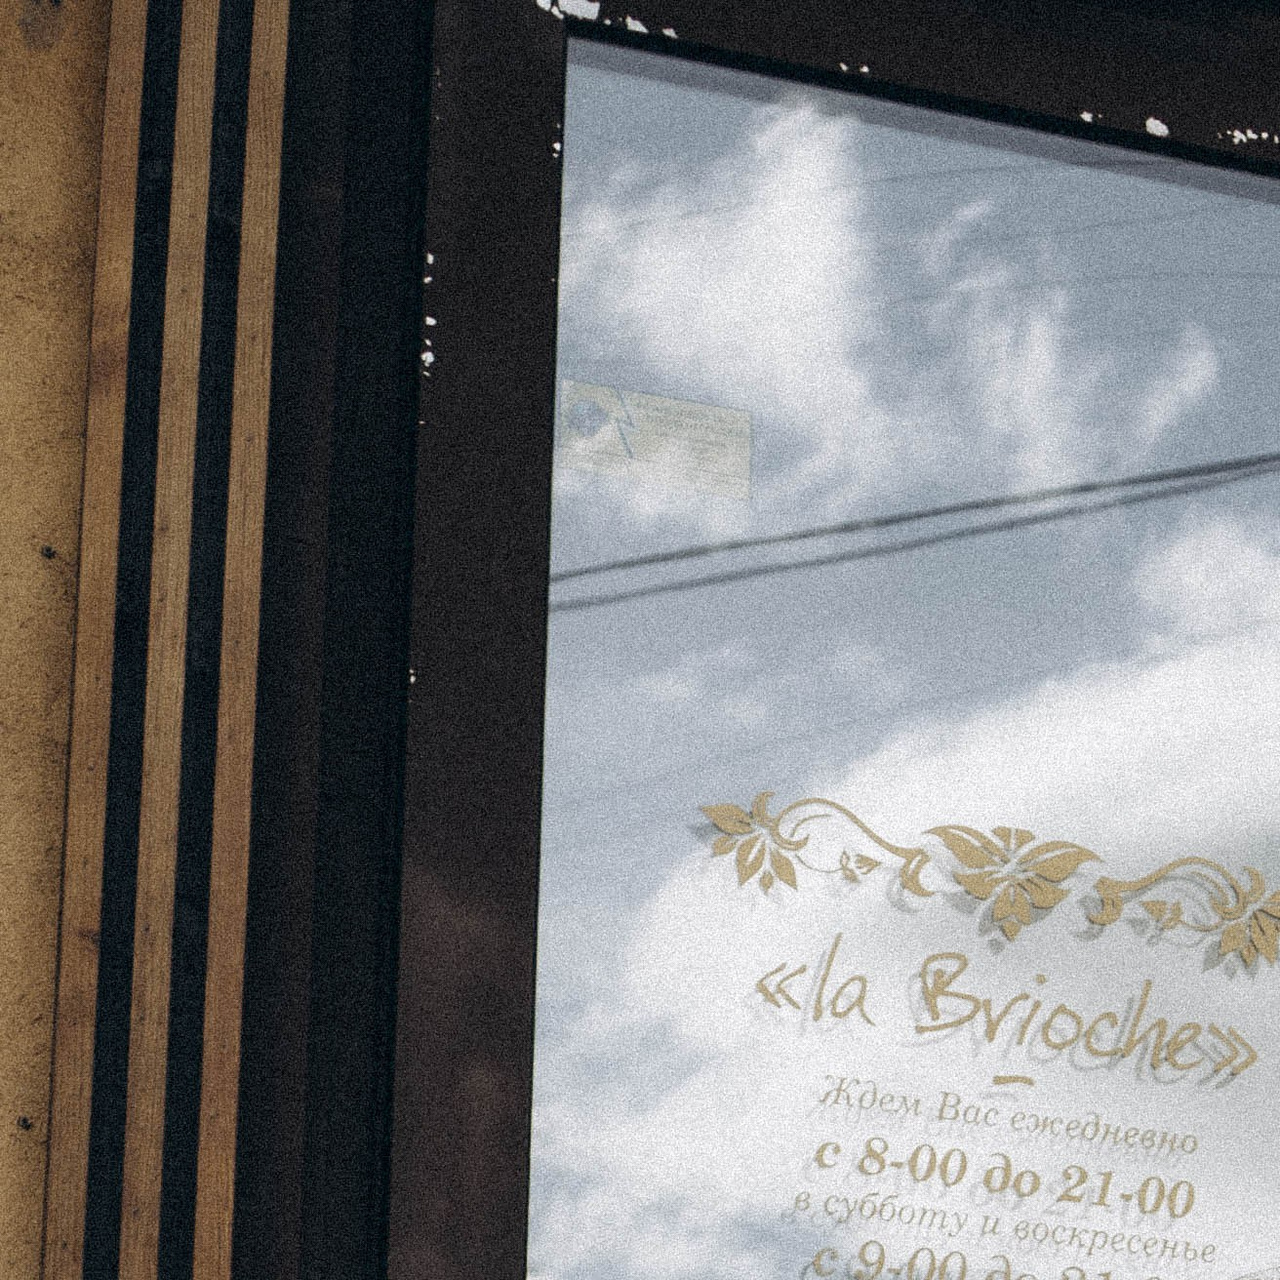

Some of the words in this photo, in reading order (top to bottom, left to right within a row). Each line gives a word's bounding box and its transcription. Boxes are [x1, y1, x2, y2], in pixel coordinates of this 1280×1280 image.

[819, 1074, 922, 1117] Ждем
[938, 1091, 1000, 1128] Вас
[1010, 1110, 1199, 1155] ежедневно
[814, 1141, 842, 1169] с
[858, 1136, 969, 1188] 8-00
[982, 1152, 1042, 1199] до
[1056, 1164, 1196, 1219] 21-00
[793, 1190, 811, 1212] в
[824, 1189, 969, 1238] субботу
[981, 1213, 1001, 1237] и
[1013, 1218, 1218, 1264] воскресенье
[812, 1247, 839, 1278] с
